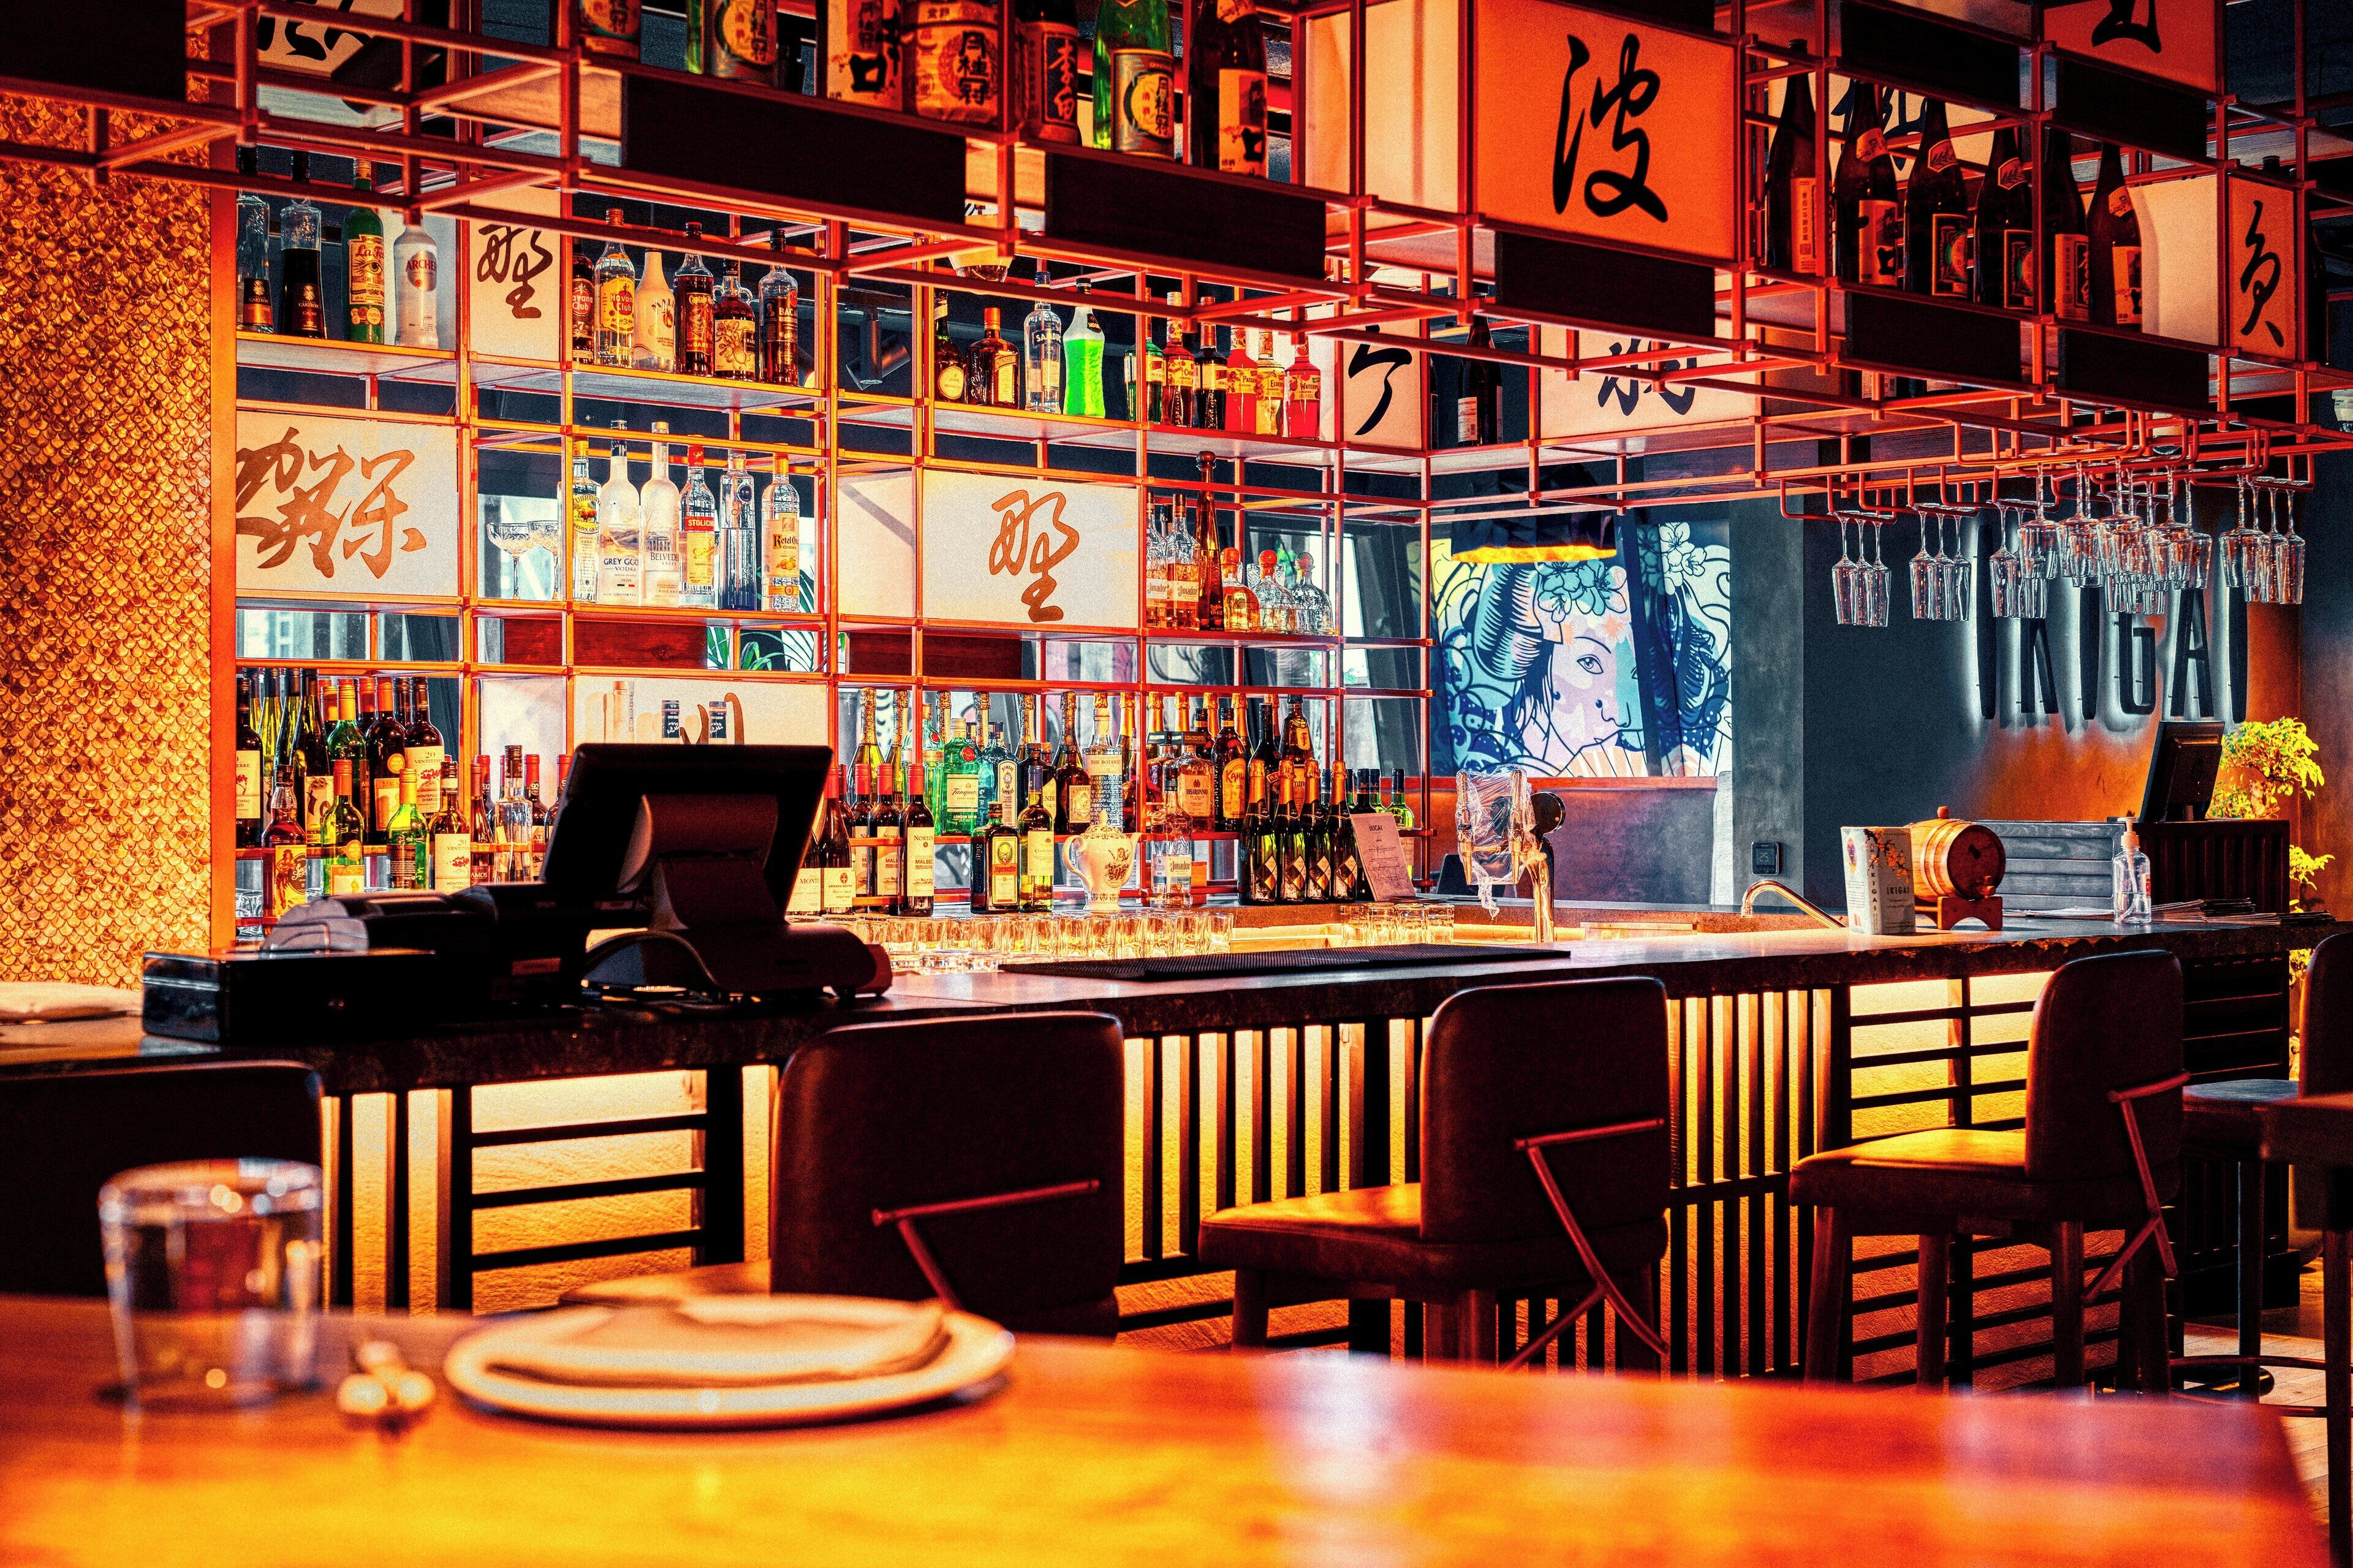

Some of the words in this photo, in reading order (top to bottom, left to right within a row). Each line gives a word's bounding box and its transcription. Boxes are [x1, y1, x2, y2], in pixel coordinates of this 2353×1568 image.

[572, 301, 589, 311] Club
[616, 303, 632, 311] Club
[773, 534, 792, 549] Ketel
[1178, 585, 1198, 596] Jimador
[1170, 861, 1191, 873] Jimador
